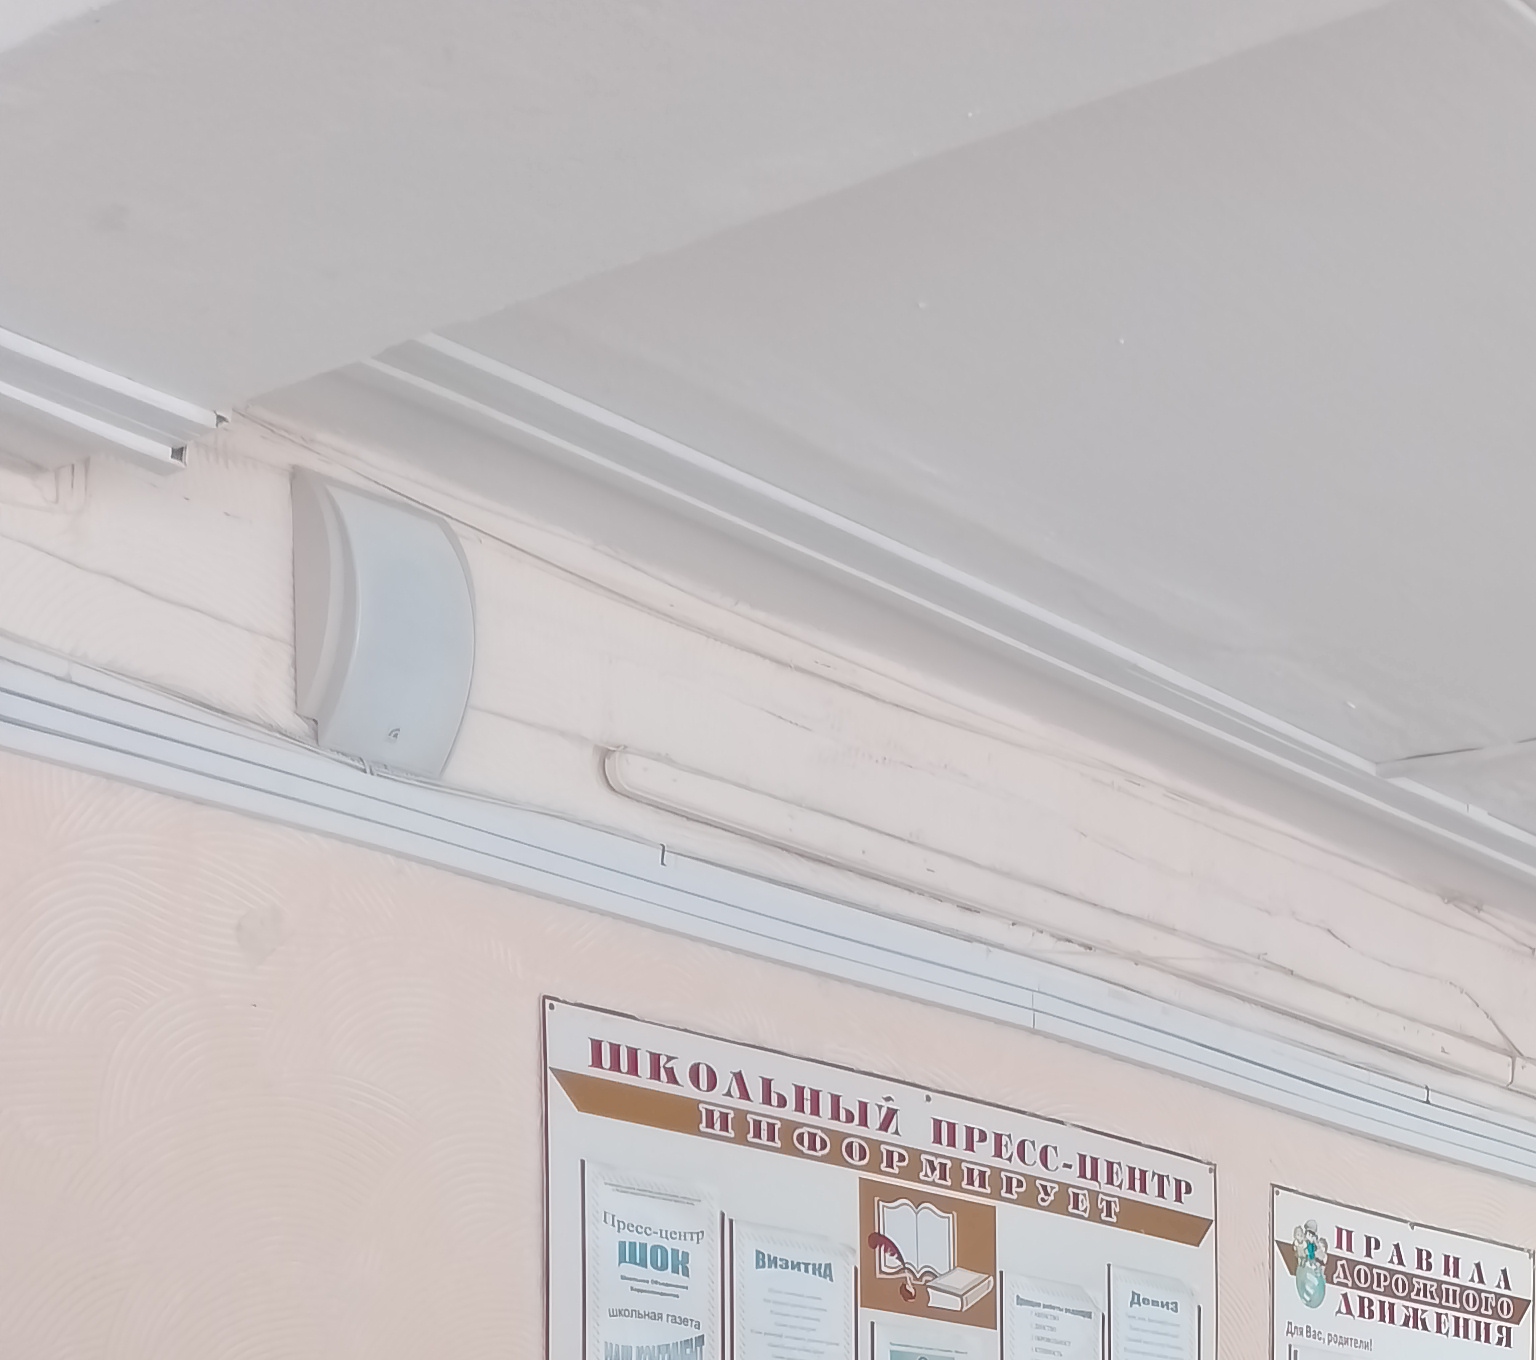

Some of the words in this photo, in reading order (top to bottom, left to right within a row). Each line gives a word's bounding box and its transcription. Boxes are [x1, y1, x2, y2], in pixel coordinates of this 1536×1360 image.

[588, 1036, 903, 1137] ШКОЛЬНЫЙ
[930, 1116, 1195, 1205] ПРЕСС-ЦЕНТР
[699, 1104, 1122, 1223] ИНФОРМИРУЕТ
[603, 1210, 705, 1245] Пресс-центр
[617, 1240, 691, 1279] ШОК
[1335, 1225, 1513, 1292] ПРАВИЛА
[1333, 1258, 1514, 1321] ДОРОЖНОГО
[608, 1307, 663, 1323] школьная
[666, 1312, 701, 1331] газета
[1285, 1320, 1304, 1338] Для
[1306, 1325, 1326, 1344] Вас,
[1327, 1333, 1373, 1352] родители!
[1335, 1291, 1514, 1349] ДВИЖЕНИЯ
